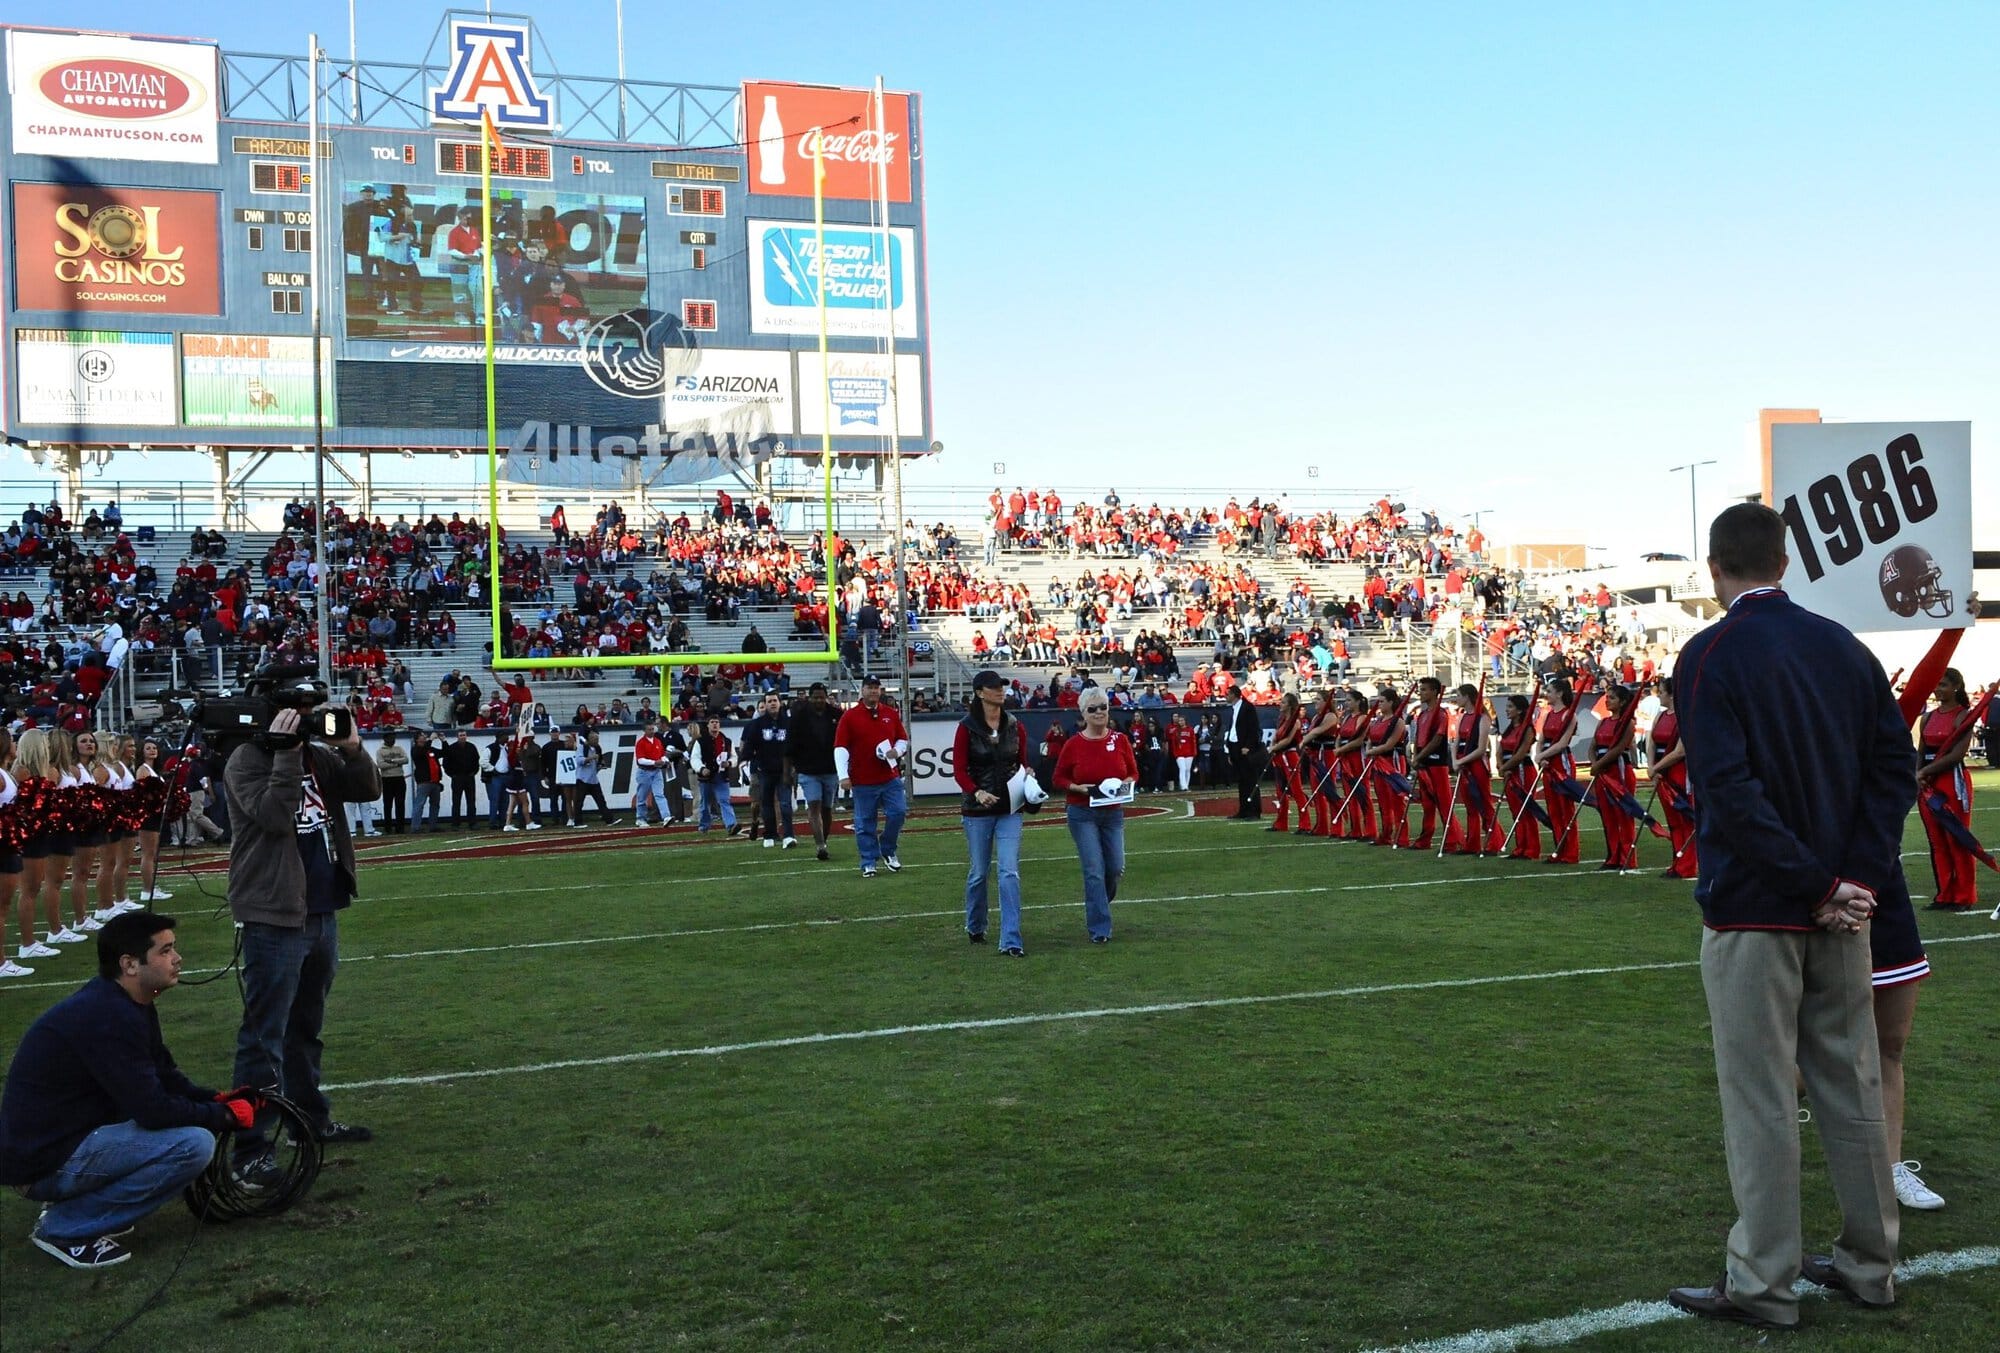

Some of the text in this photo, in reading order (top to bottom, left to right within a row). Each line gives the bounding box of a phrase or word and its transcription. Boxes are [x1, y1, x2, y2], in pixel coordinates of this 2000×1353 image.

[61, 69, 167, 97] CHAPMAN
[432, 24, 551, 126] A
[63, 93, 168, 110] AUTOMOTIVE
[28, 124, 204, 144] CHAPMANTUCSON.COM
[370, 146, 401, 160] TOL
[586, 160, 615, 174] TOL
[676, 165, 714, 180] UTAH
[243, 209, 265, 223] DWN
[283, 211, 311, 225] TO GO
[54, 203, 184, 260] SOL
[690, 231, 706, 245] QTR
[799, 237, 871, 260] Tucson
[54, 259, 186, 286] CASINOS
[267, 273, 305, 287] BALL ON
[76, 291, 167, 303] SOLCASINOS.COM
[816, 277, 887, 299] Power
[184, 336, 270, 358] BRAKE
[675, 375, 780, 393] FS ARIZONA
[1780, 433, 1938, 583] 1986
[915, 642, 930, 652] 29
[560, 755, 576, 773] 19
